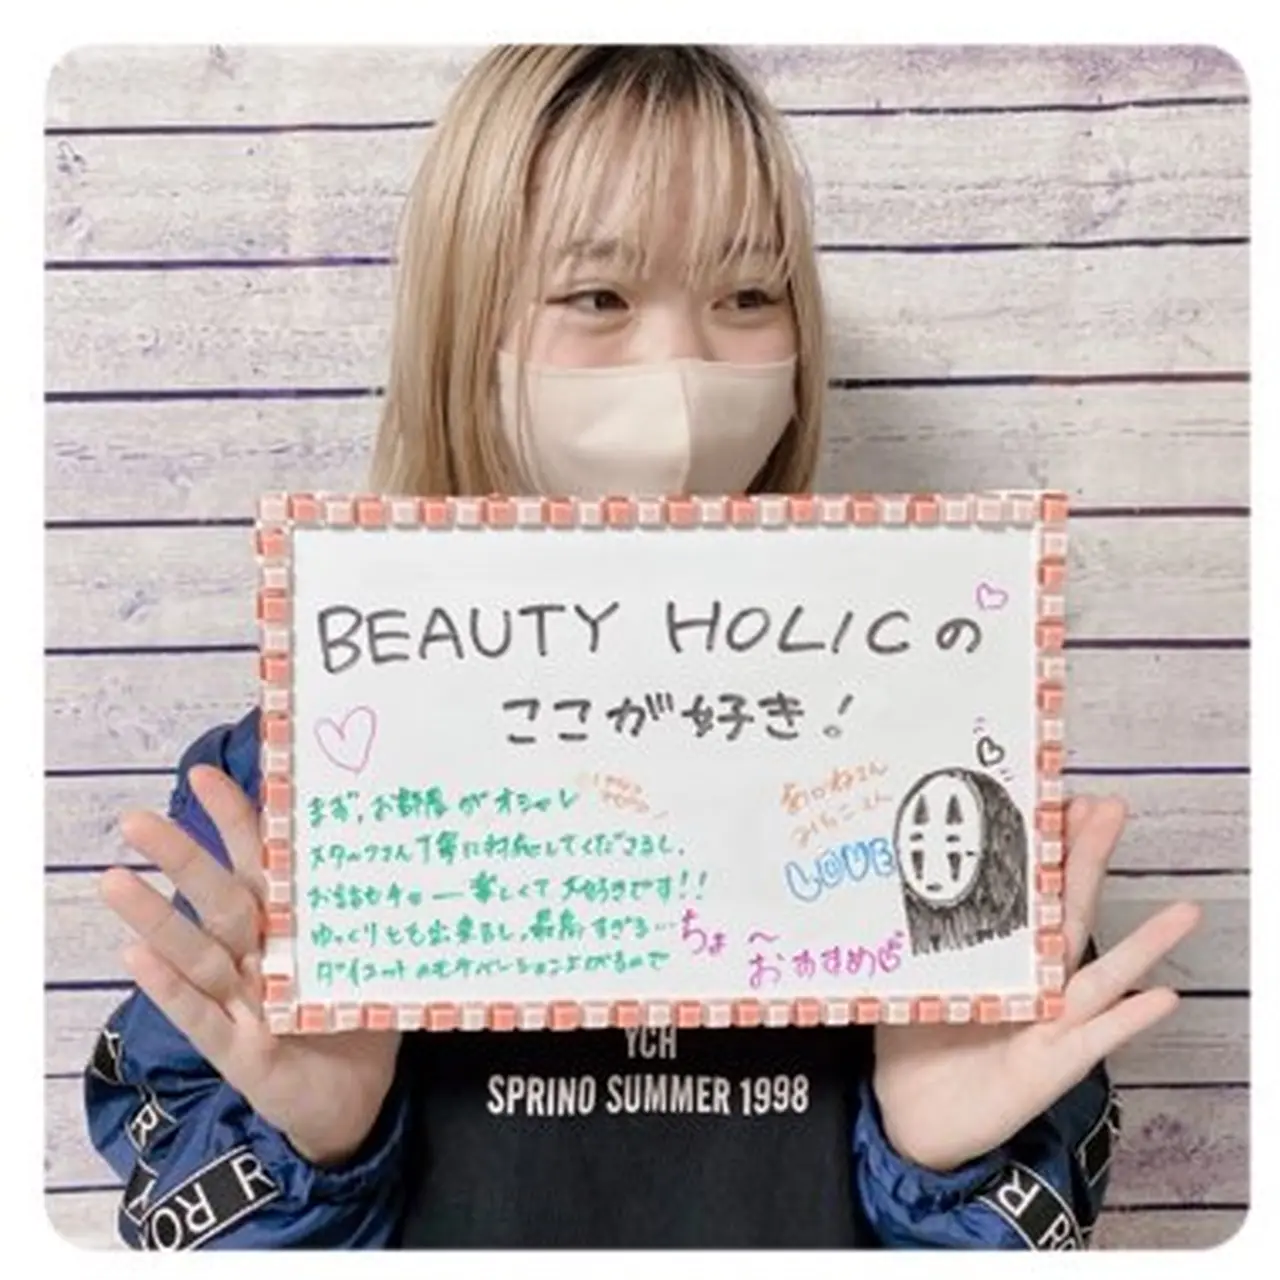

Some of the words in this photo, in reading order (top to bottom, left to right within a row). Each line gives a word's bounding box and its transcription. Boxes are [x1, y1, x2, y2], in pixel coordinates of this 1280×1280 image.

[317, 601, 620, 675] BEAUTY
[784, 837, 898, 904] LOVE
[604, 1074, 731, 1116] SUMMER
[740, 1074, 810, 1116] 1998
